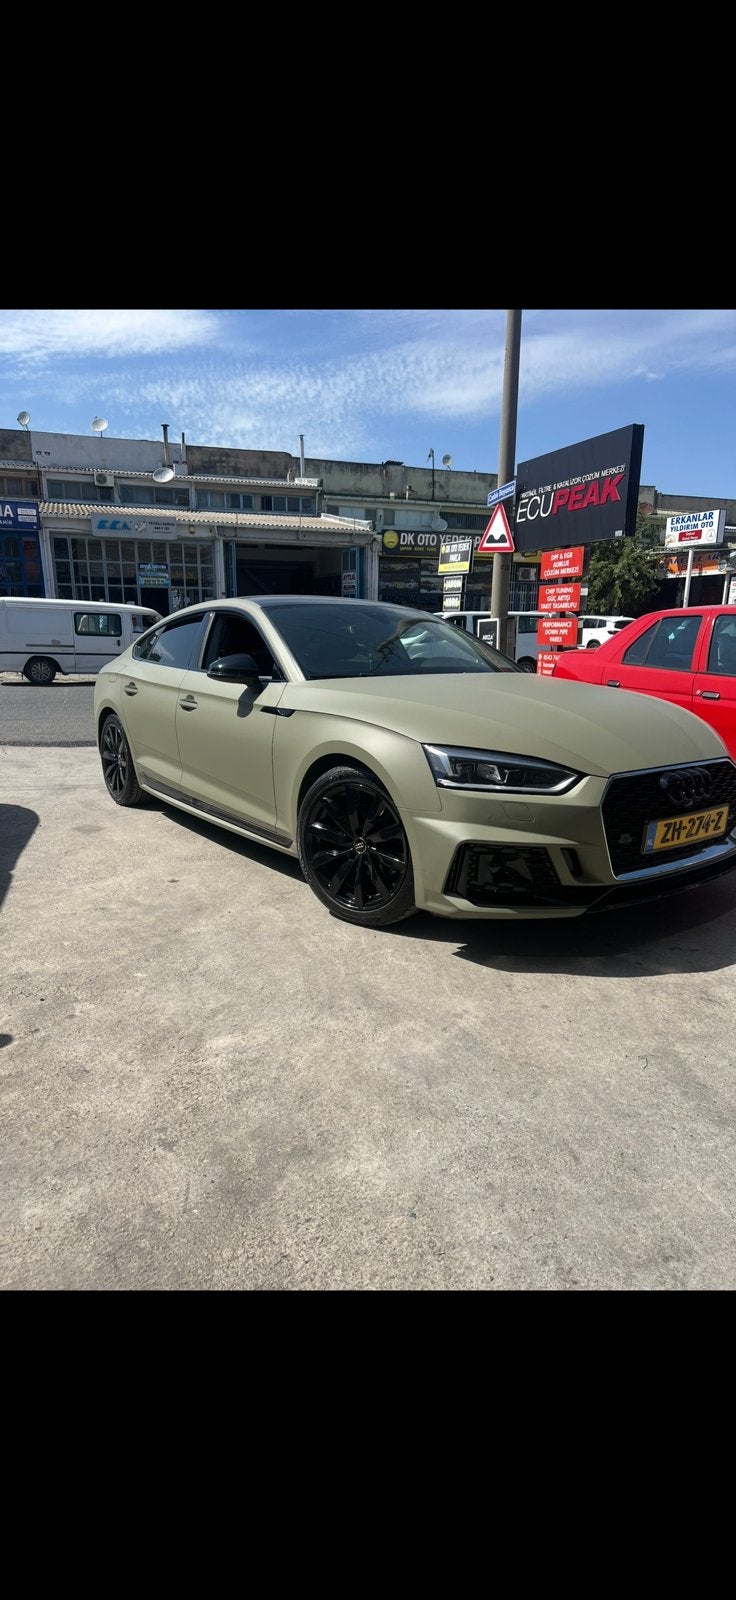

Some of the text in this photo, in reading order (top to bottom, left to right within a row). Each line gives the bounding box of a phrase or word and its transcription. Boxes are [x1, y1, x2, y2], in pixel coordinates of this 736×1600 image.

[671, 512, 714, 525] ERKANLAR
[670, 523, 699, 532] YILDIRIM
[400, 533, 415, 545] DK
[418, 534, 437, 546] OTO
[661, 811, 724, 844] ZH-274-Z
